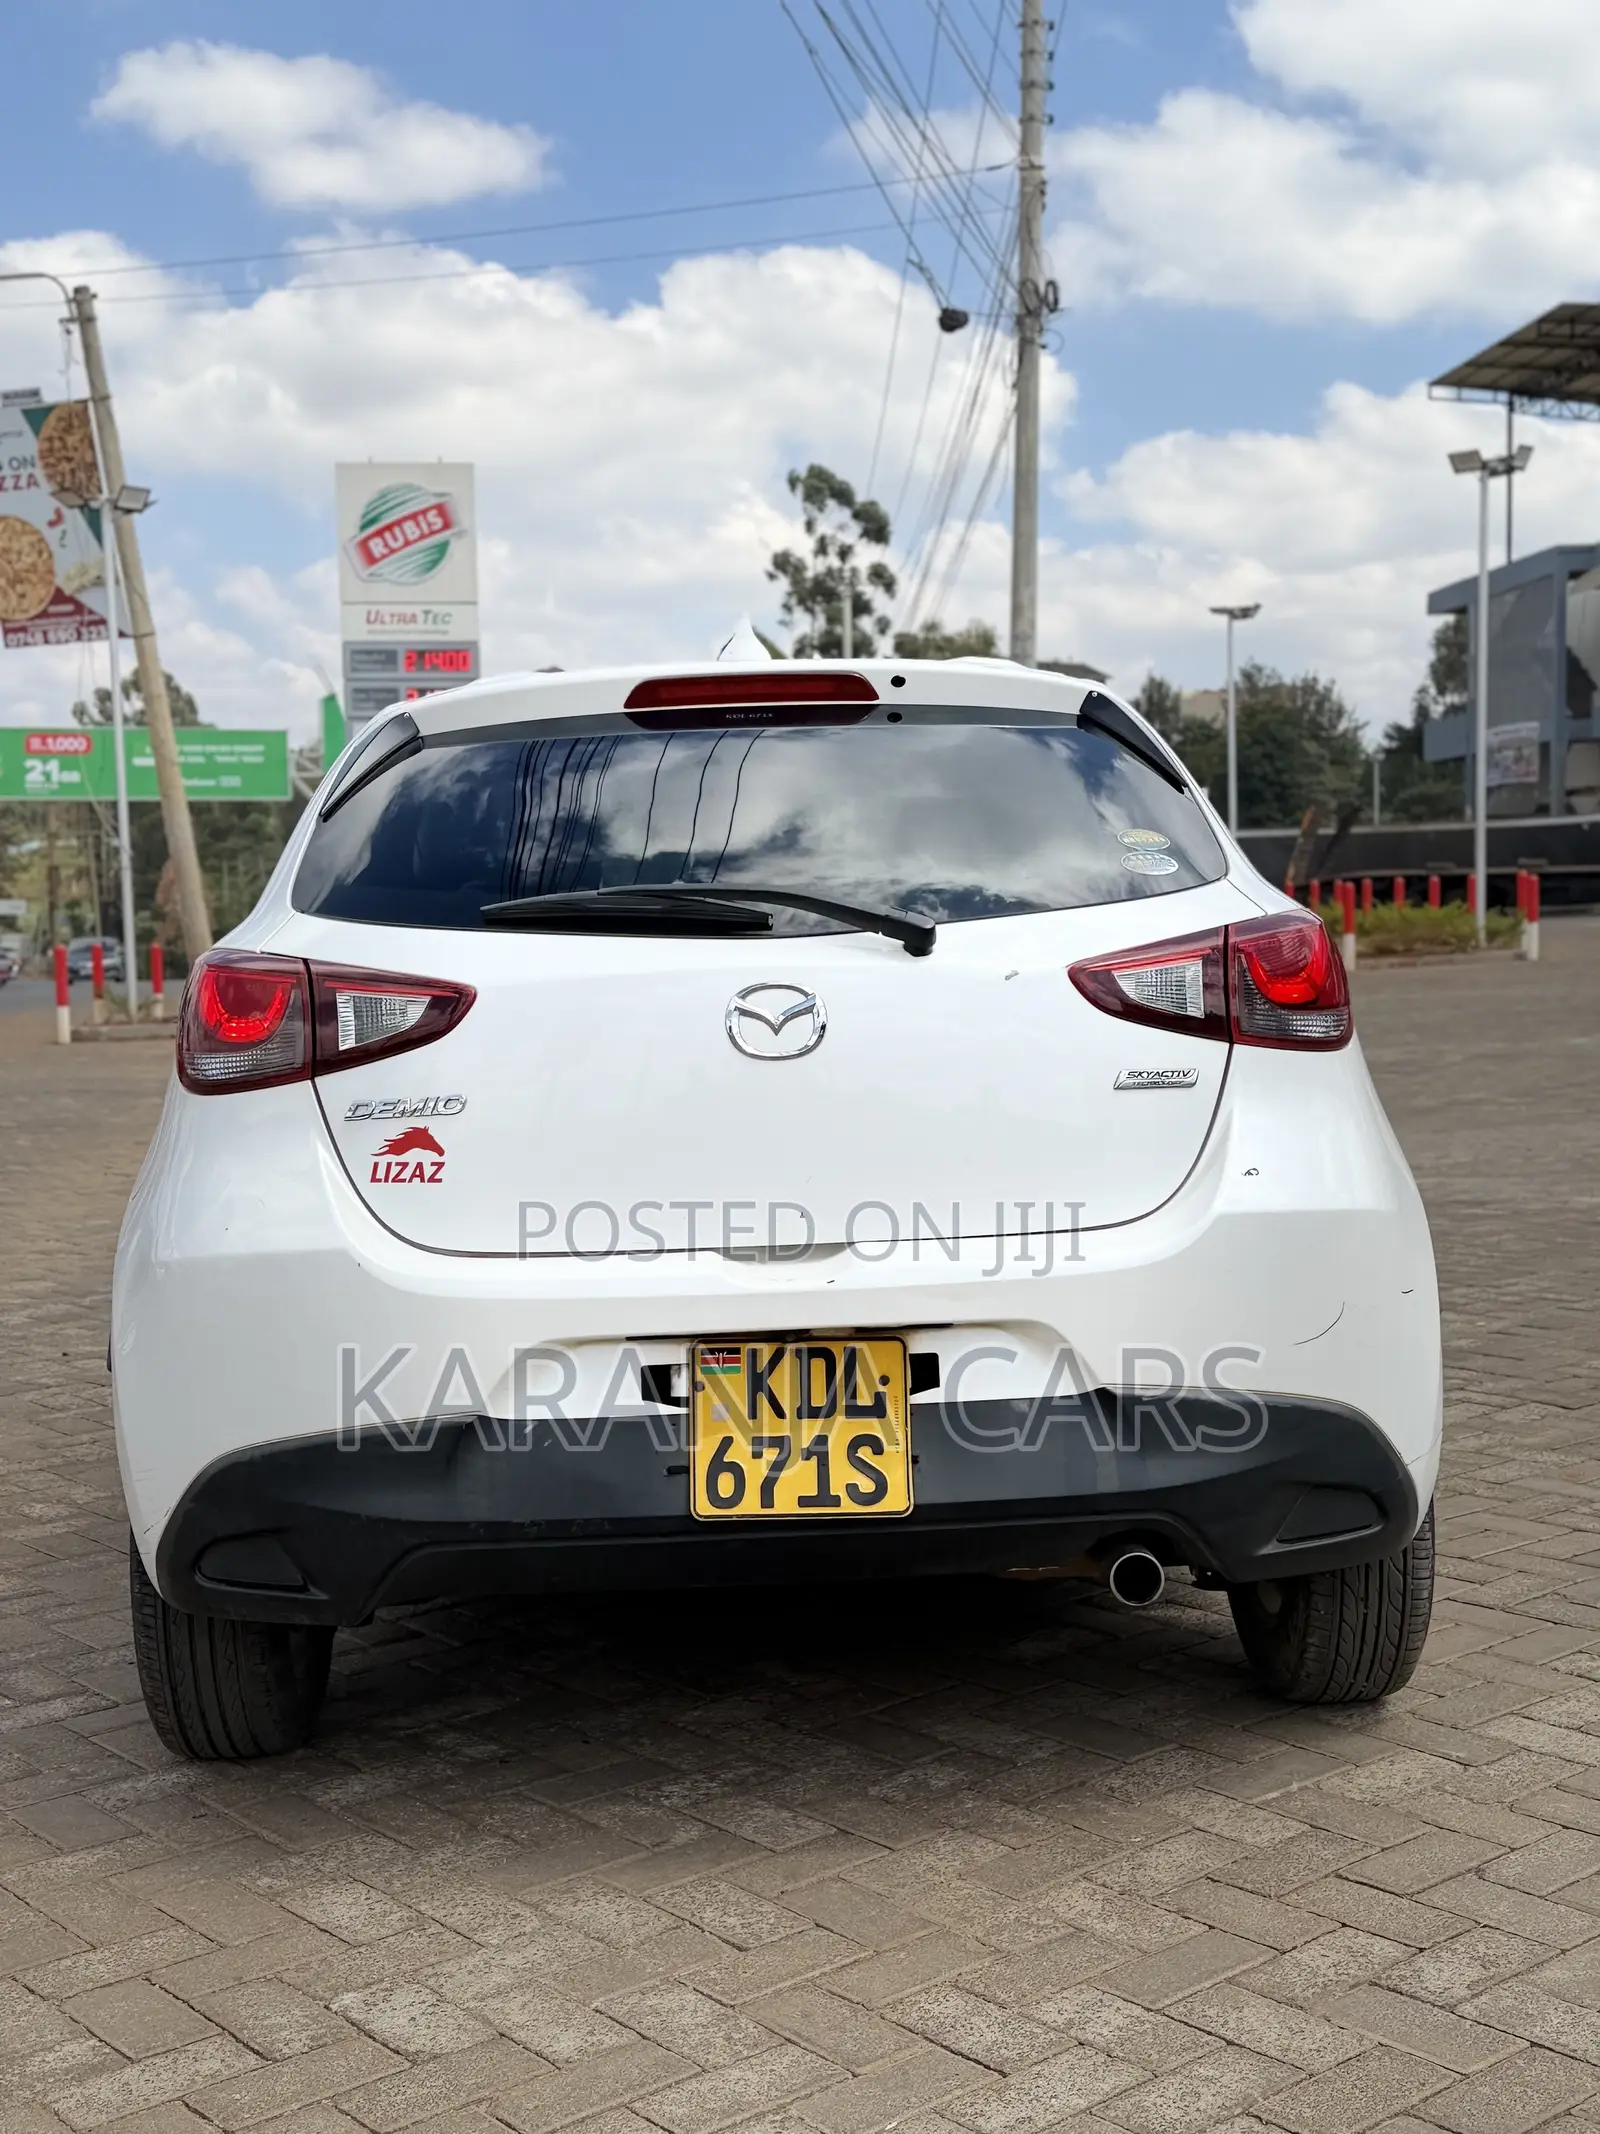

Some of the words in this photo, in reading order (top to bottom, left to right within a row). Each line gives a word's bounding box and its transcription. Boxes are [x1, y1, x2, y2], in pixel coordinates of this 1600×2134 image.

[366, 609, 418, 626] ULTRA
[421, 609, 453, 626] TEC
[1126, 1070, 1192, 1079] SKYACTIV
[344, 1094, 467, 1121] DEMIO
[369, 1161, 446, 1184] LIZAZ
[746, 1345, 887, 1420] KDL
[705, 1433, 889, 1509] 671S
